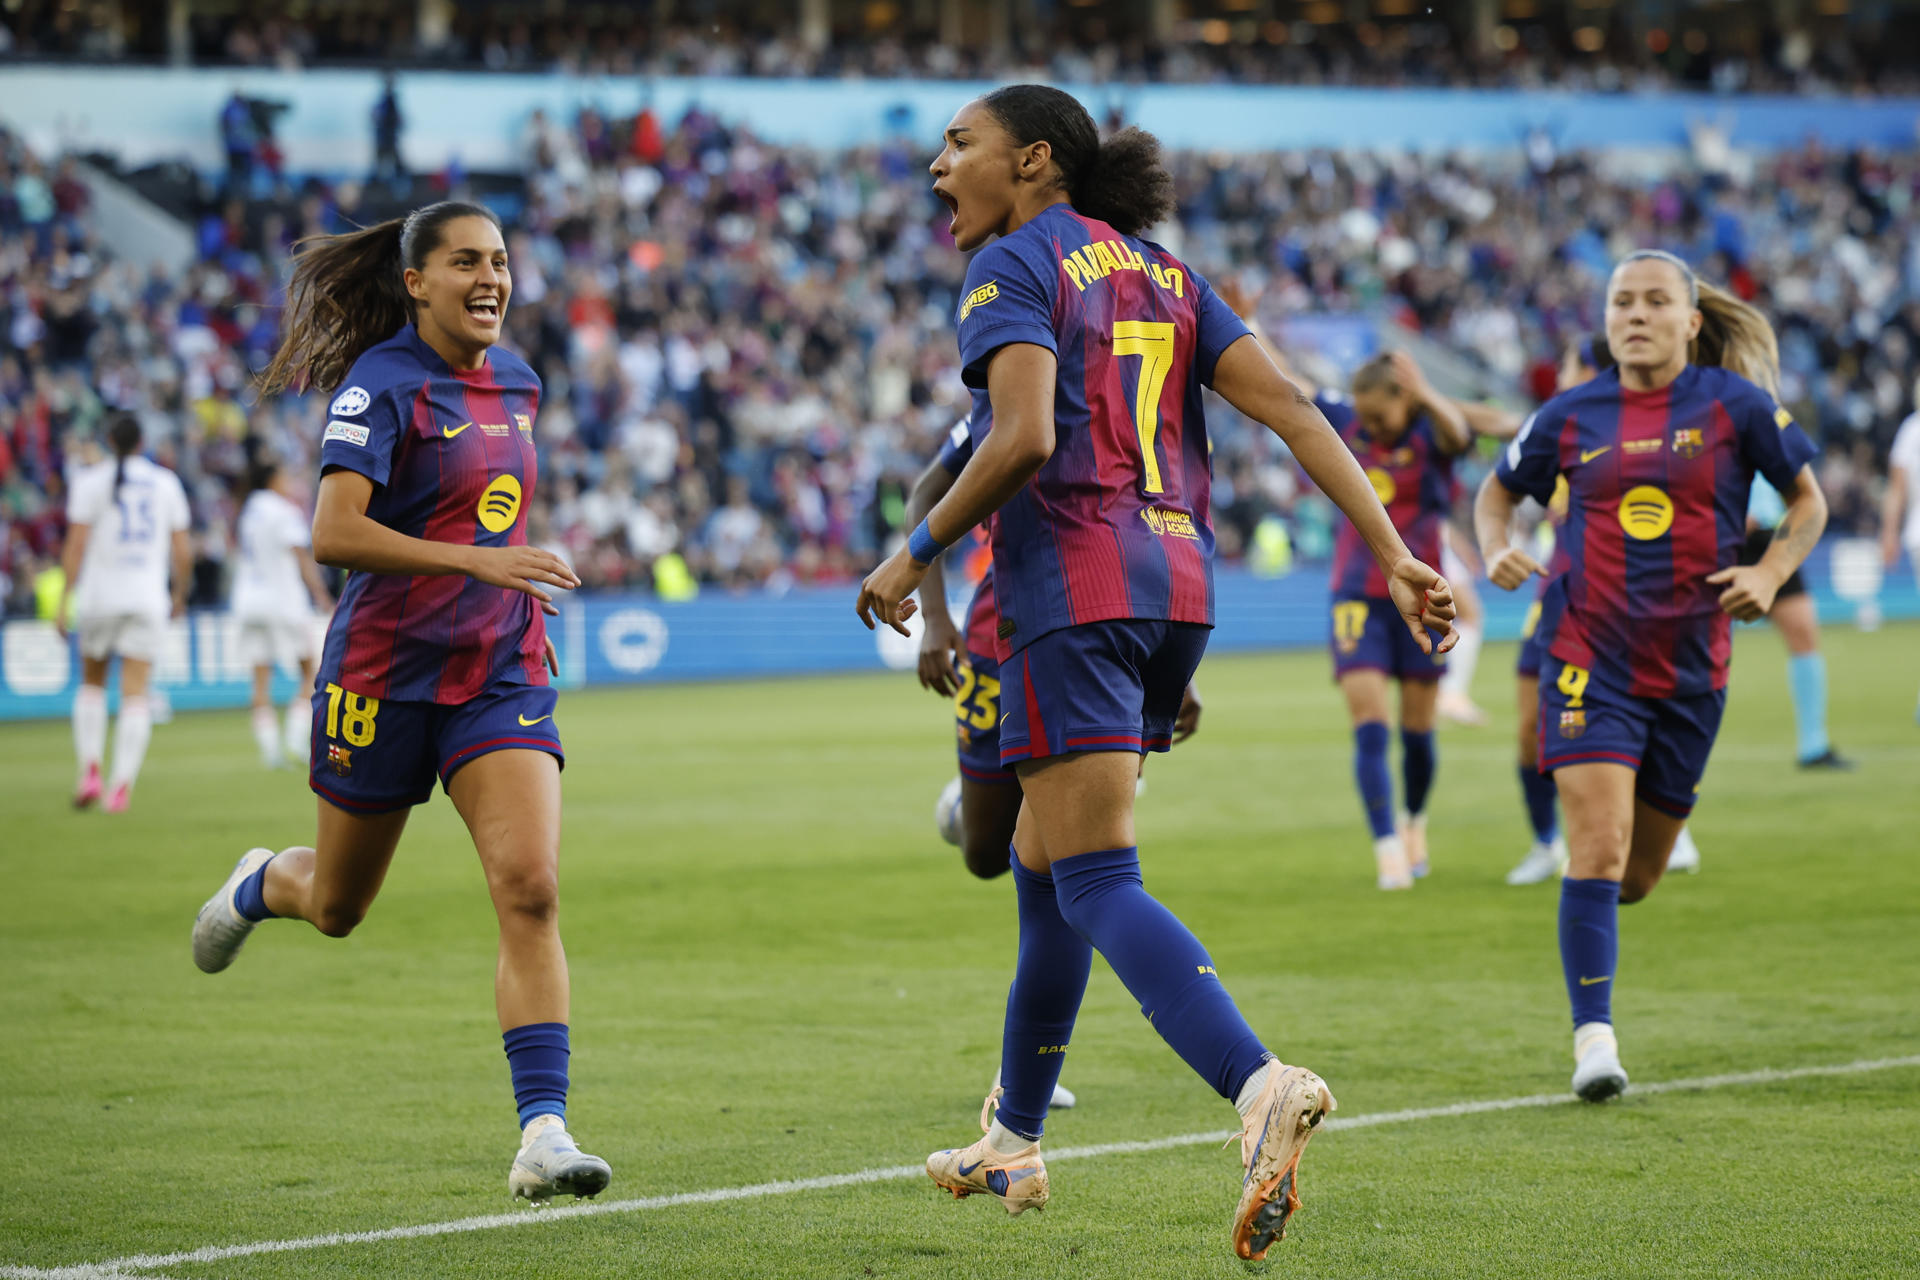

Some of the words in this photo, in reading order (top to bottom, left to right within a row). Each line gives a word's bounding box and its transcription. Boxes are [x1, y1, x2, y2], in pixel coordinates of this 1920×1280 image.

[1112, 320, 1175, 493] 7
[325, 682, 380, 748] 18
[955, 664, 1001, 730] 23
[1557, 663, 1590, 708] 9
